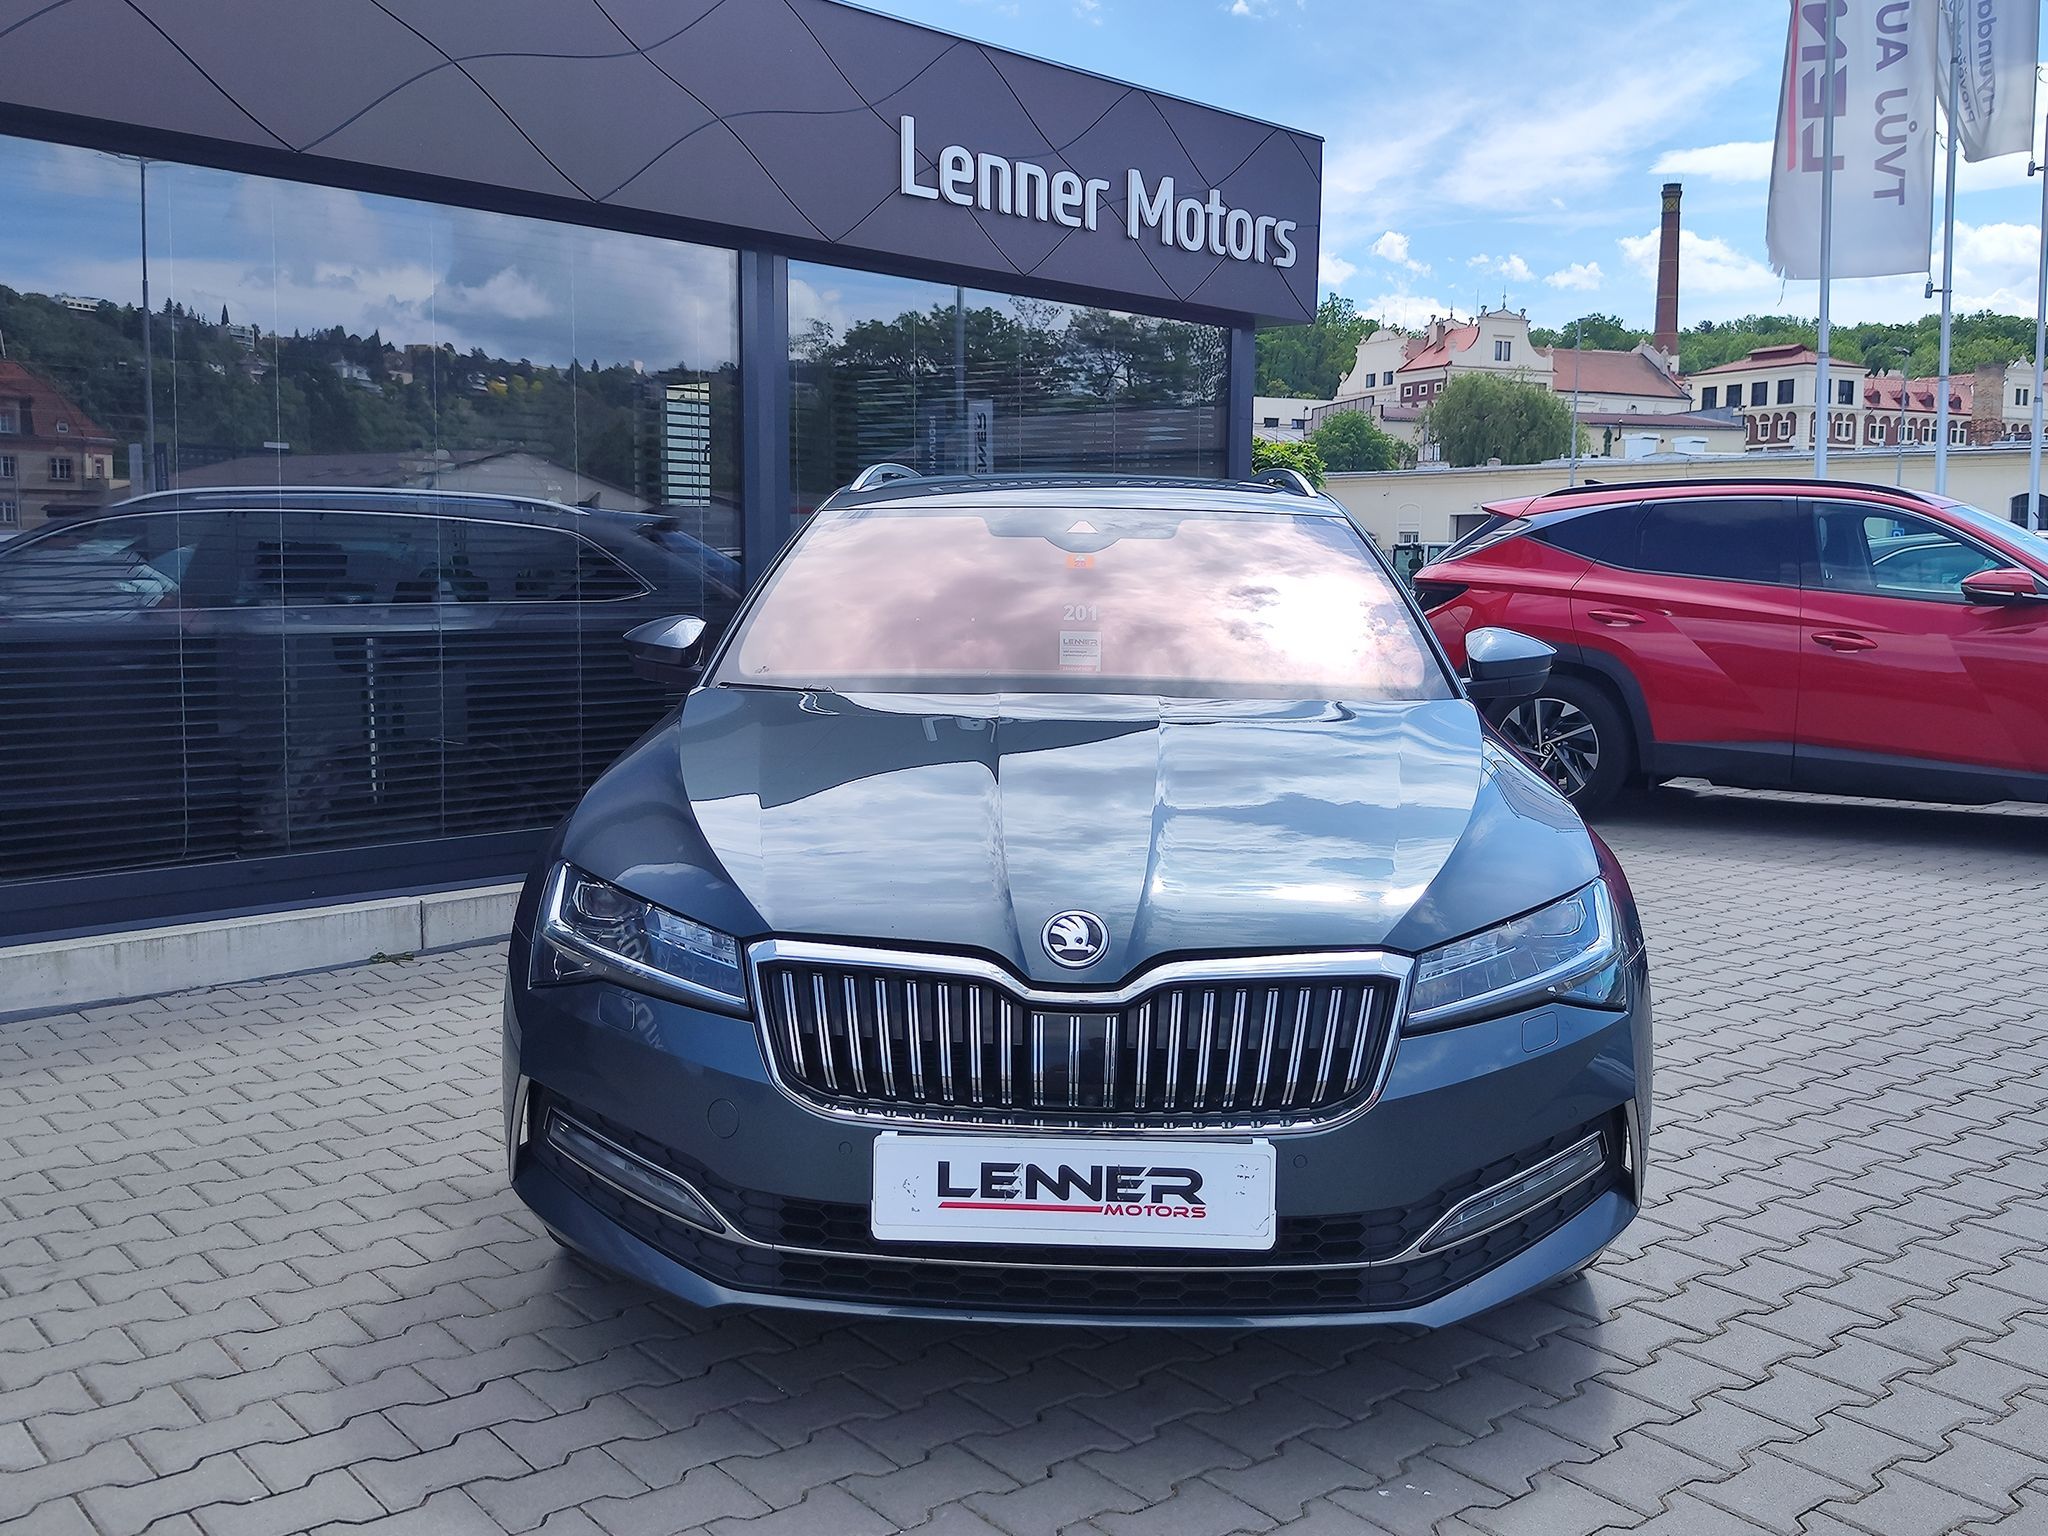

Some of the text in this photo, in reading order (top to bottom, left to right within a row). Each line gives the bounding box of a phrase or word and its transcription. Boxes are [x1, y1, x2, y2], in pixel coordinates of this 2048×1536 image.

[900, 114, 1298, 268] Lenner Motors
[937, 1160, 1206, 1205] LENNER
[1102, 1203, 1207, 1219] MOTORS
